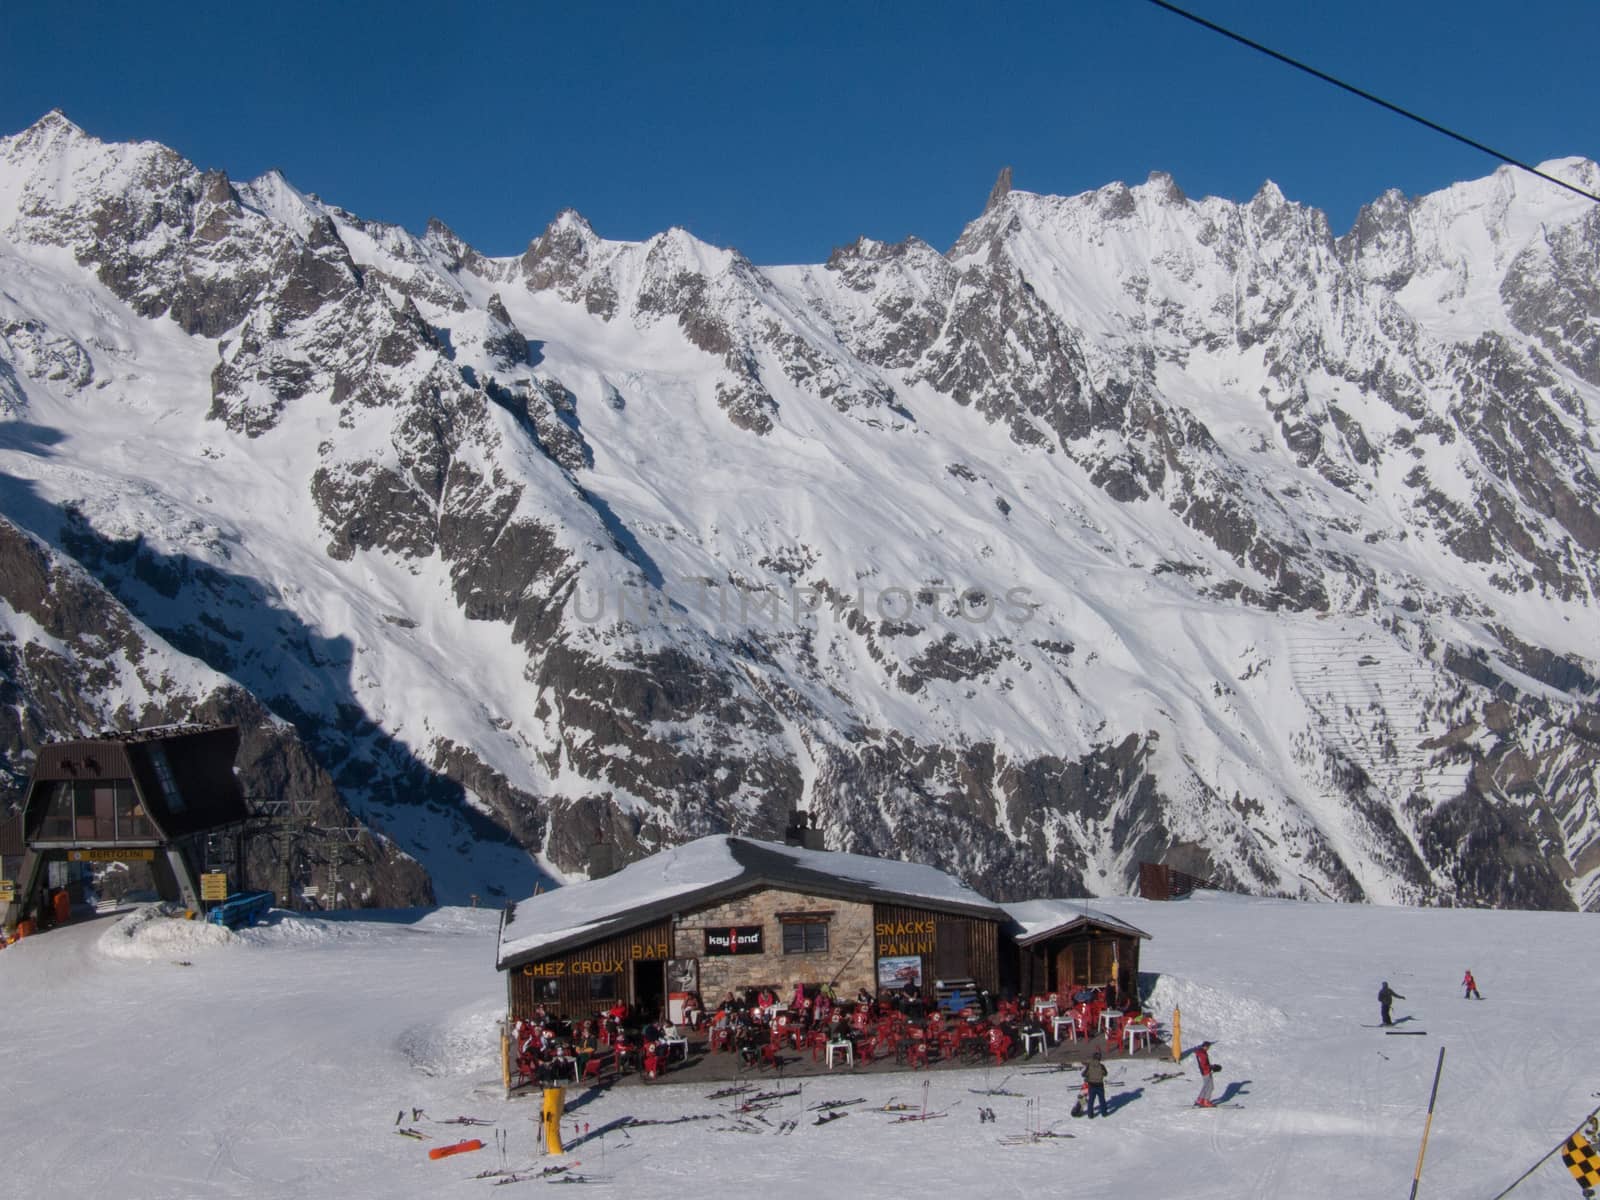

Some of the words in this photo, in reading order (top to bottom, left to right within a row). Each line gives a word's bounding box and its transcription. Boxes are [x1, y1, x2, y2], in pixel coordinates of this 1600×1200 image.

[876, 920, 936, 935] SNACKS
[631, 944, 668, 959] BAR
[880, 941, 932, 955] PANINI
[523, 963, 564, 976] CHEZ
[571, 960, 624, 974] CROUX
